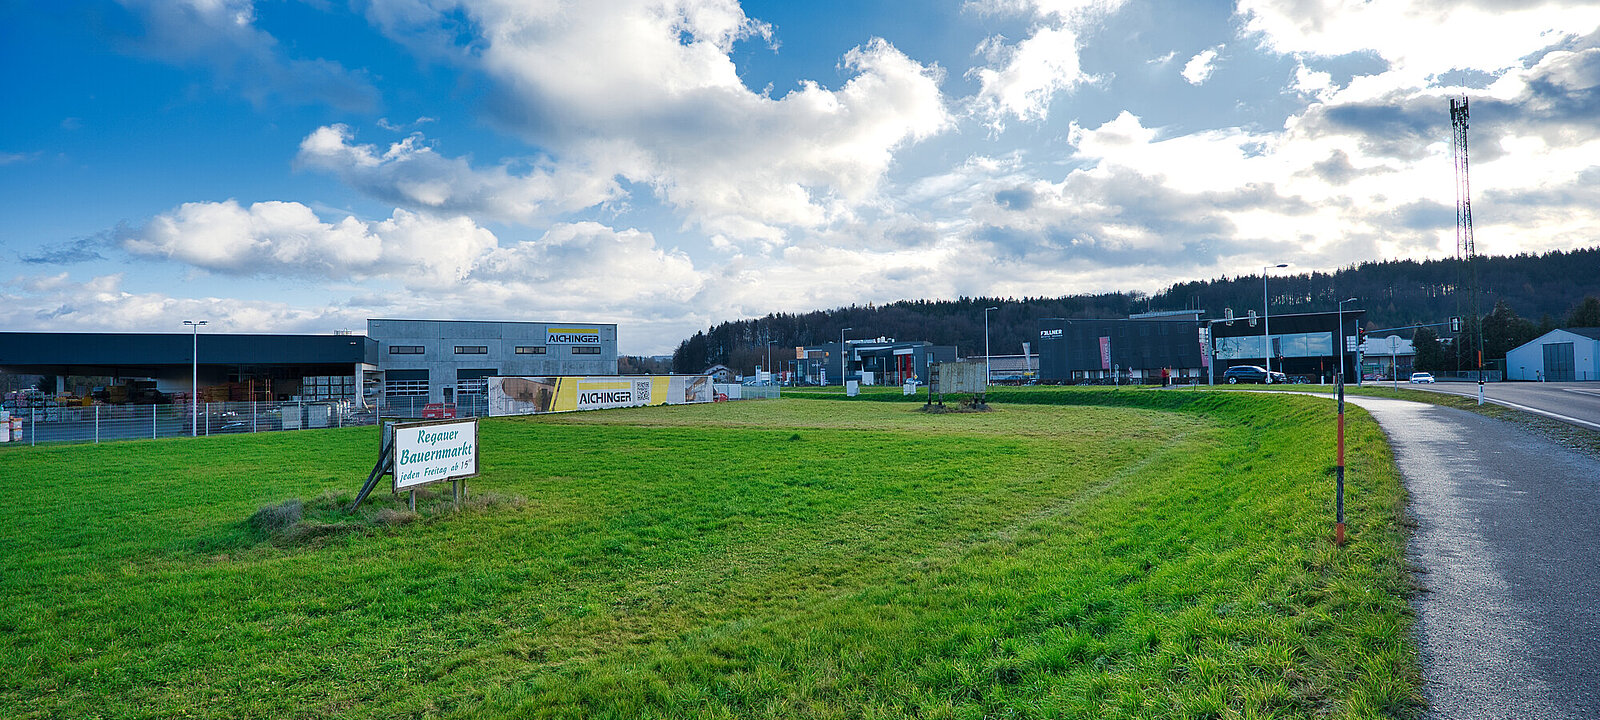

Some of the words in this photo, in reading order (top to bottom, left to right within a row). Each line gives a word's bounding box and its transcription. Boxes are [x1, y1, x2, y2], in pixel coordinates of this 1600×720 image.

[548, 335, 599, 343] AICHINGER
[579, 391, 631, 404] AICHINGER
[417, 429, 459, 446] Regauer
[400, 441, 472, 465] Bauernmarkt
[400, 470, 420, 483] jeden
[424, 466, 447, 477] Freitag
[450, 462, 459, 471] ab
